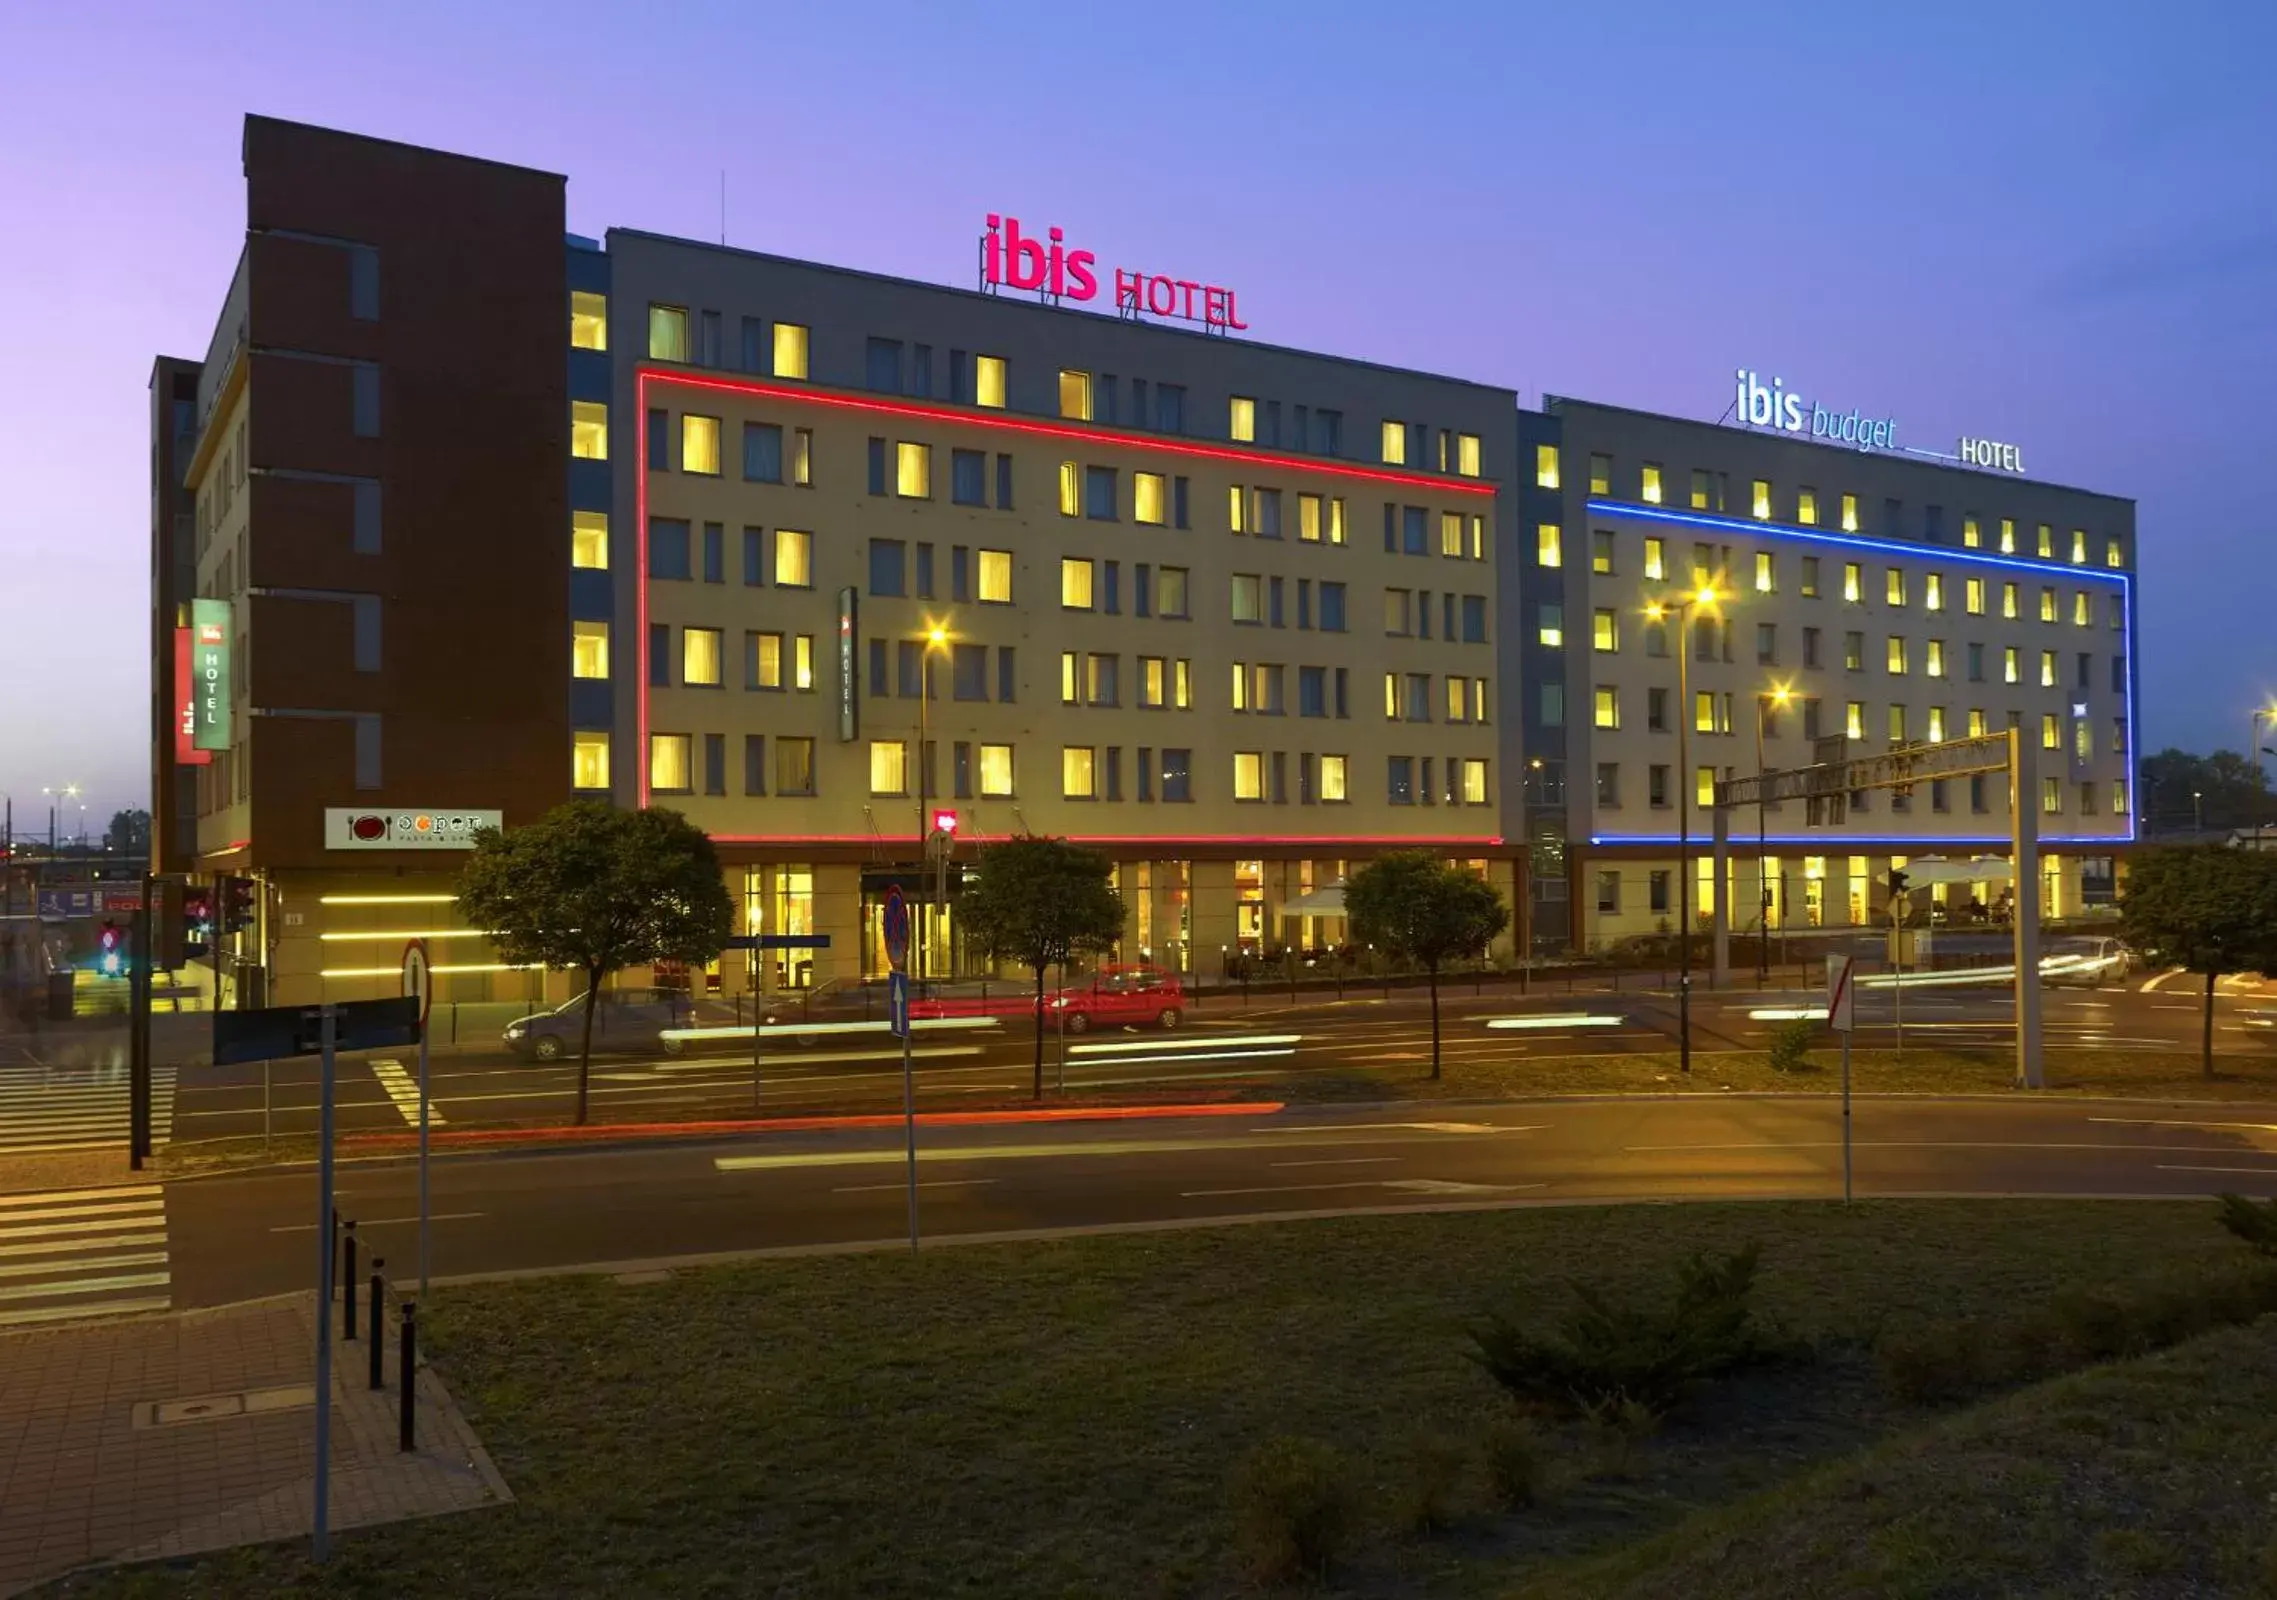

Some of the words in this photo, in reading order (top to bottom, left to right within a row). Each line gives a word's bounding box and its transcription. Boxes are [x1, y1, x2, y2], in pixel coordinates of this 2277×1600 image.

[985, 212, 1098, 302] ibis
[1116, 267, 1249, 330] HOTEL
[1736, 369, 1803, 432] ibis
[1812, 401, 1897, 453] budget
[1961, 437, 2026, 473] HOTEL
[205, 653, 219, 724] HOTEL
